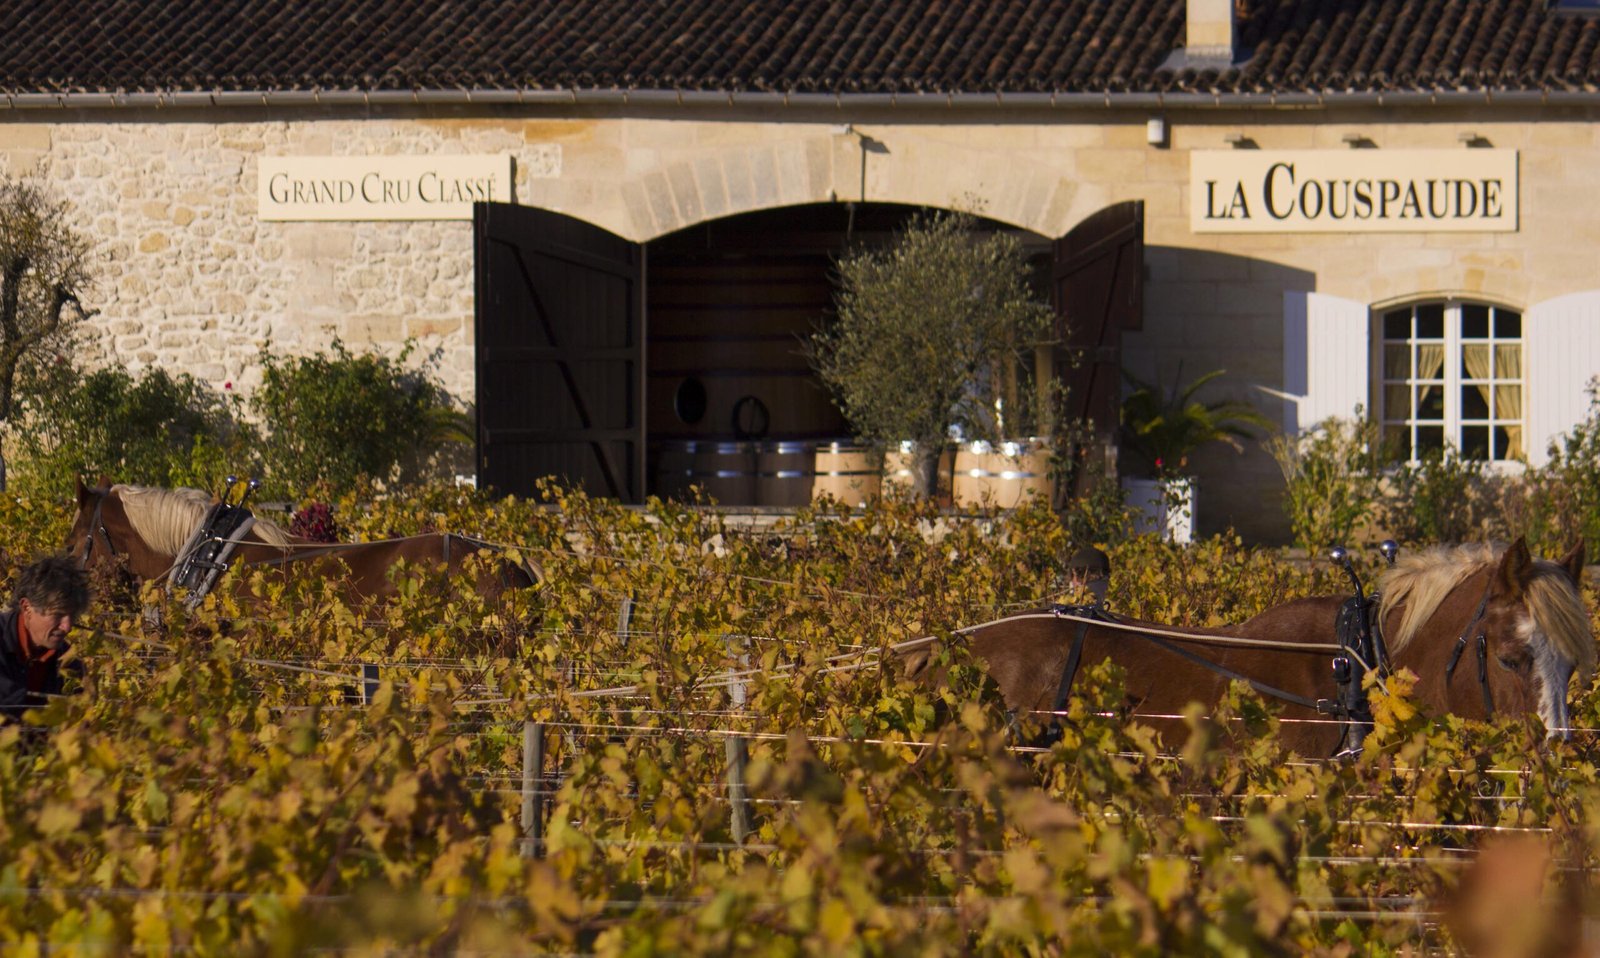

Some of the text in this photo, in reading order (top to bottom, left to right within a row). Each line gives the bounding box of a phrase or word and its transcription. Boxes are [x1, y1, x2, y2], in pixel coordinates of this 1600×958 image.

[268, 171, 497, 204] GRAND CRU CLASSÉ
[1204, 162, 1502, 220] LA COUSPAUDE
